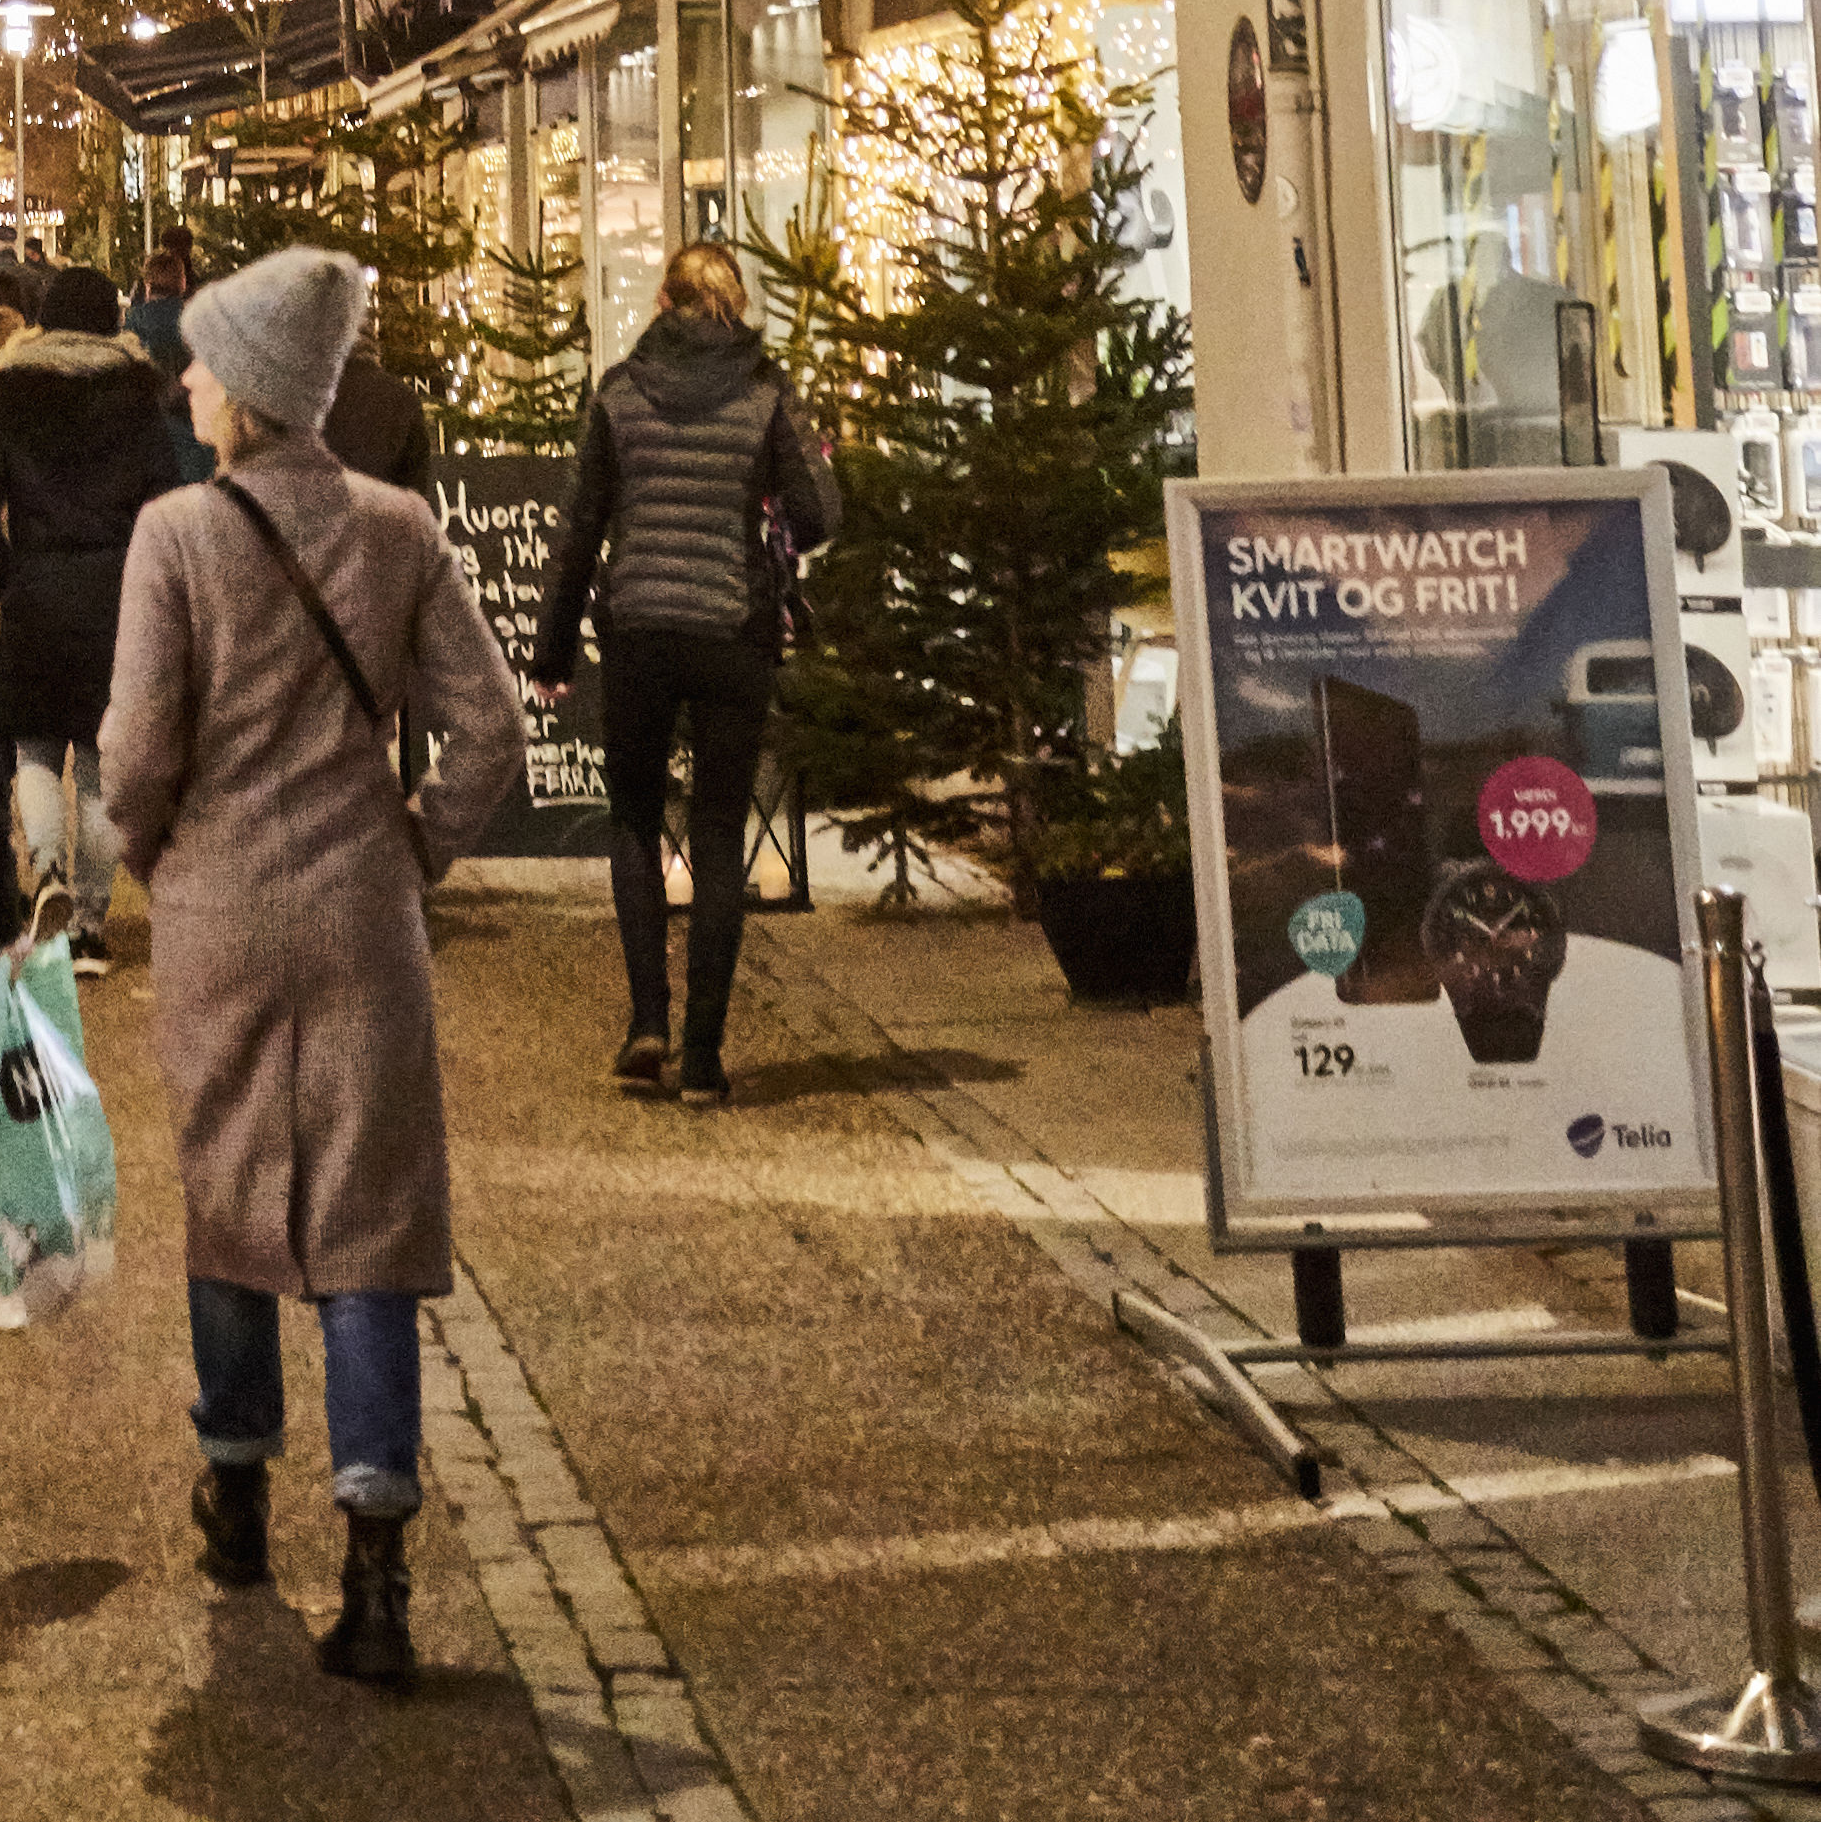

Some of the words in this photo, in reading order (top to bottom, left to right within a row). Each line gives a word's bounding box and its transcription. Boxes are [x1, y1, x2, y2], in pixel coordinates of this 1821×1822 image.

[1227, 528, 1528, 575] SMARTWATCH
[1231, 579, 1325, 620] KVIT
[1336, 577, 1405, 617] OG
[1415, 574, 1518, 615] FRIT!
[1294, 1042, 1355, 1077] 129
[1611, 1123, 1672, 1148] Telia
